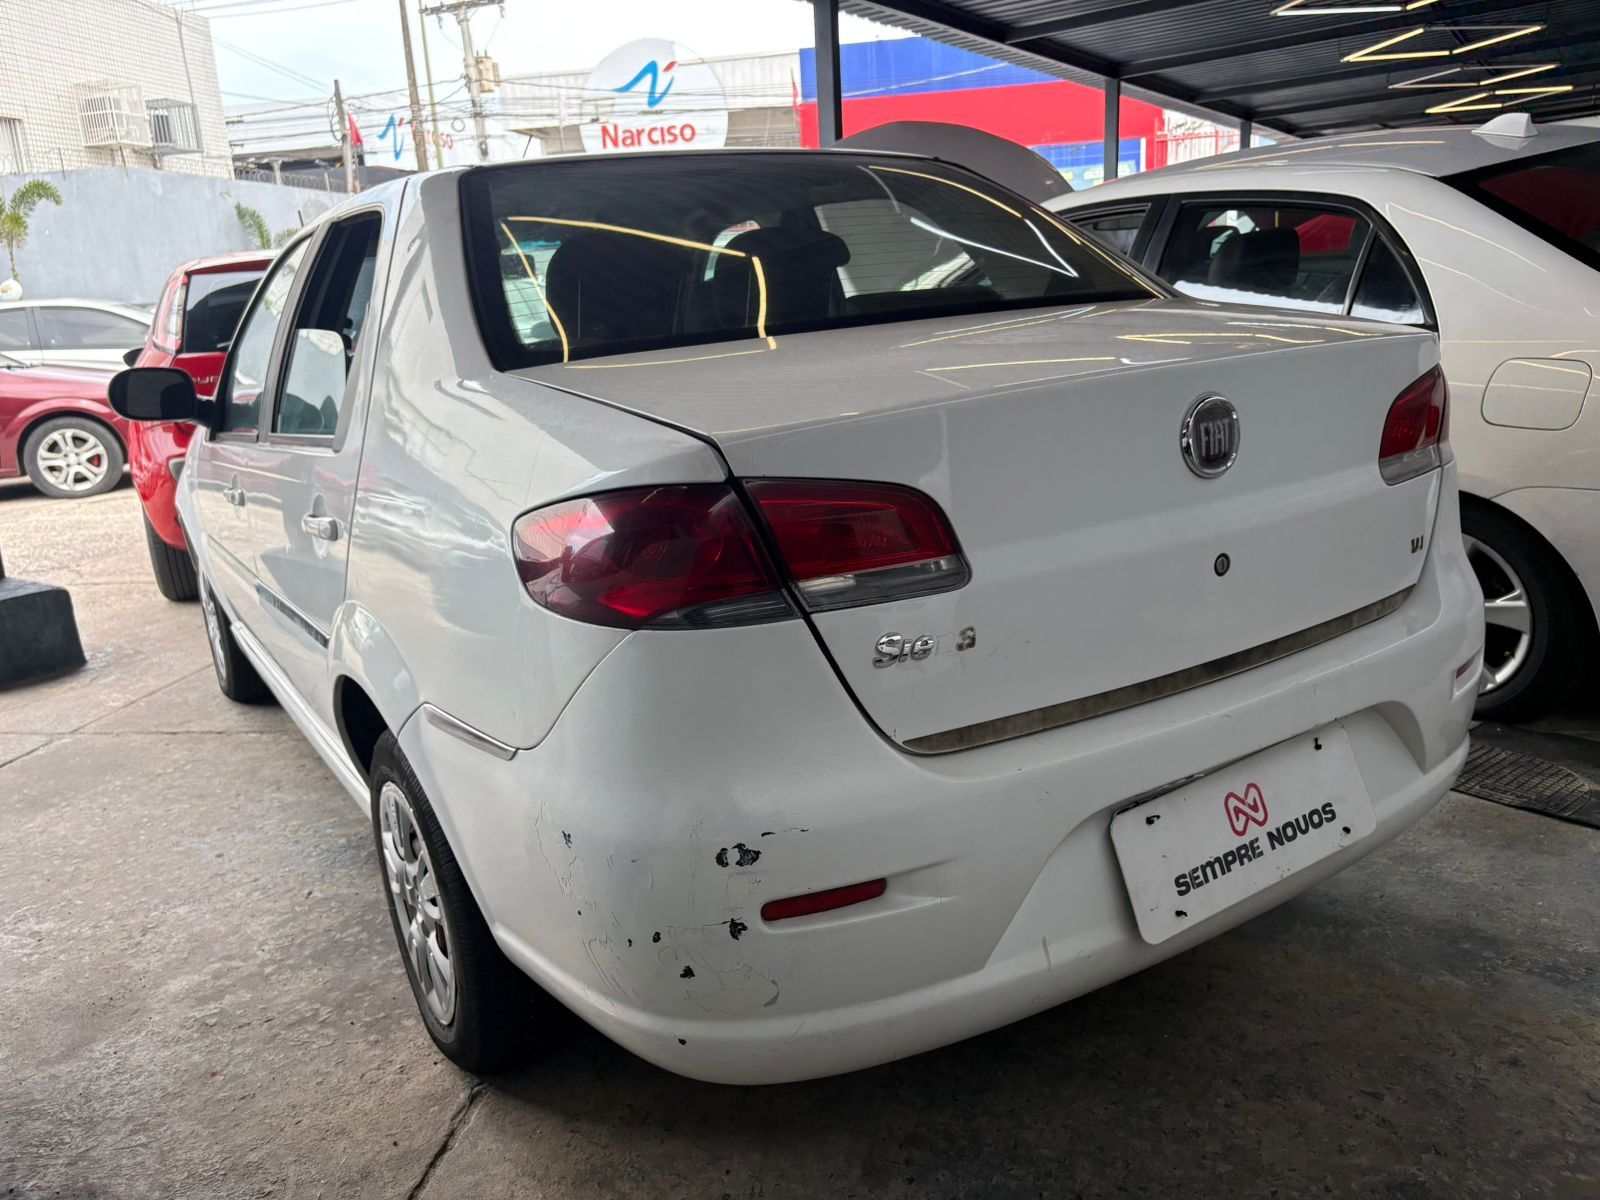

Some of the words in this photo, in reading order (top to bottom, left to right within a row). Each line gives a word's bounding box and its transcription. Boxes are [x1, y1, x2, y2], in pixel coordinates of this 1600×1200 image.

[600, 123, 697, 149] Narciso
[1200, 418, 1231, 457] FIAT
[1174, 837, 1264, 897] SEMPRE
